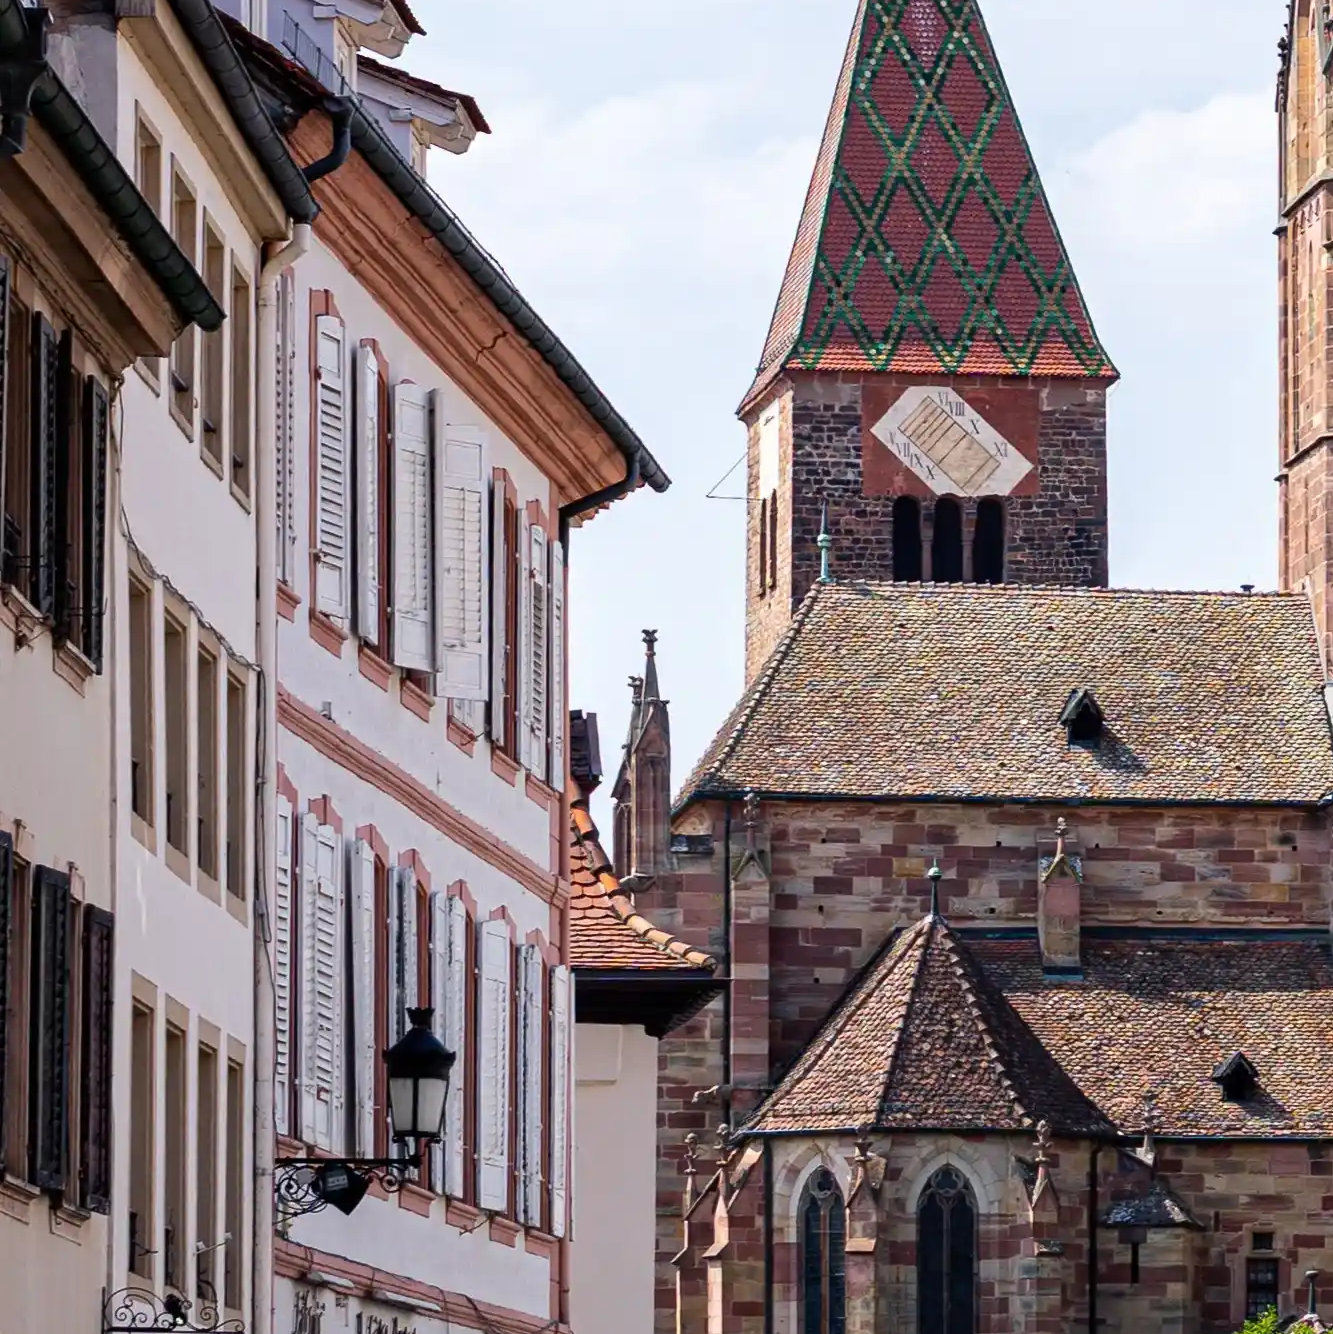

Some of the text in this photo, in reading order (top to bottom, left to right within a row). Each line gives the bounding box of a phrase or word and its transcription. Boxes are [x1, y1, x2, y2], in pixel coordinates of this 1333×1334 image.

[948, 401, 966, 417] VIII
[968, 418, 980, 435] X
[993, 441, 1008, 458] XI
[895, 442, 910, 458] VII
